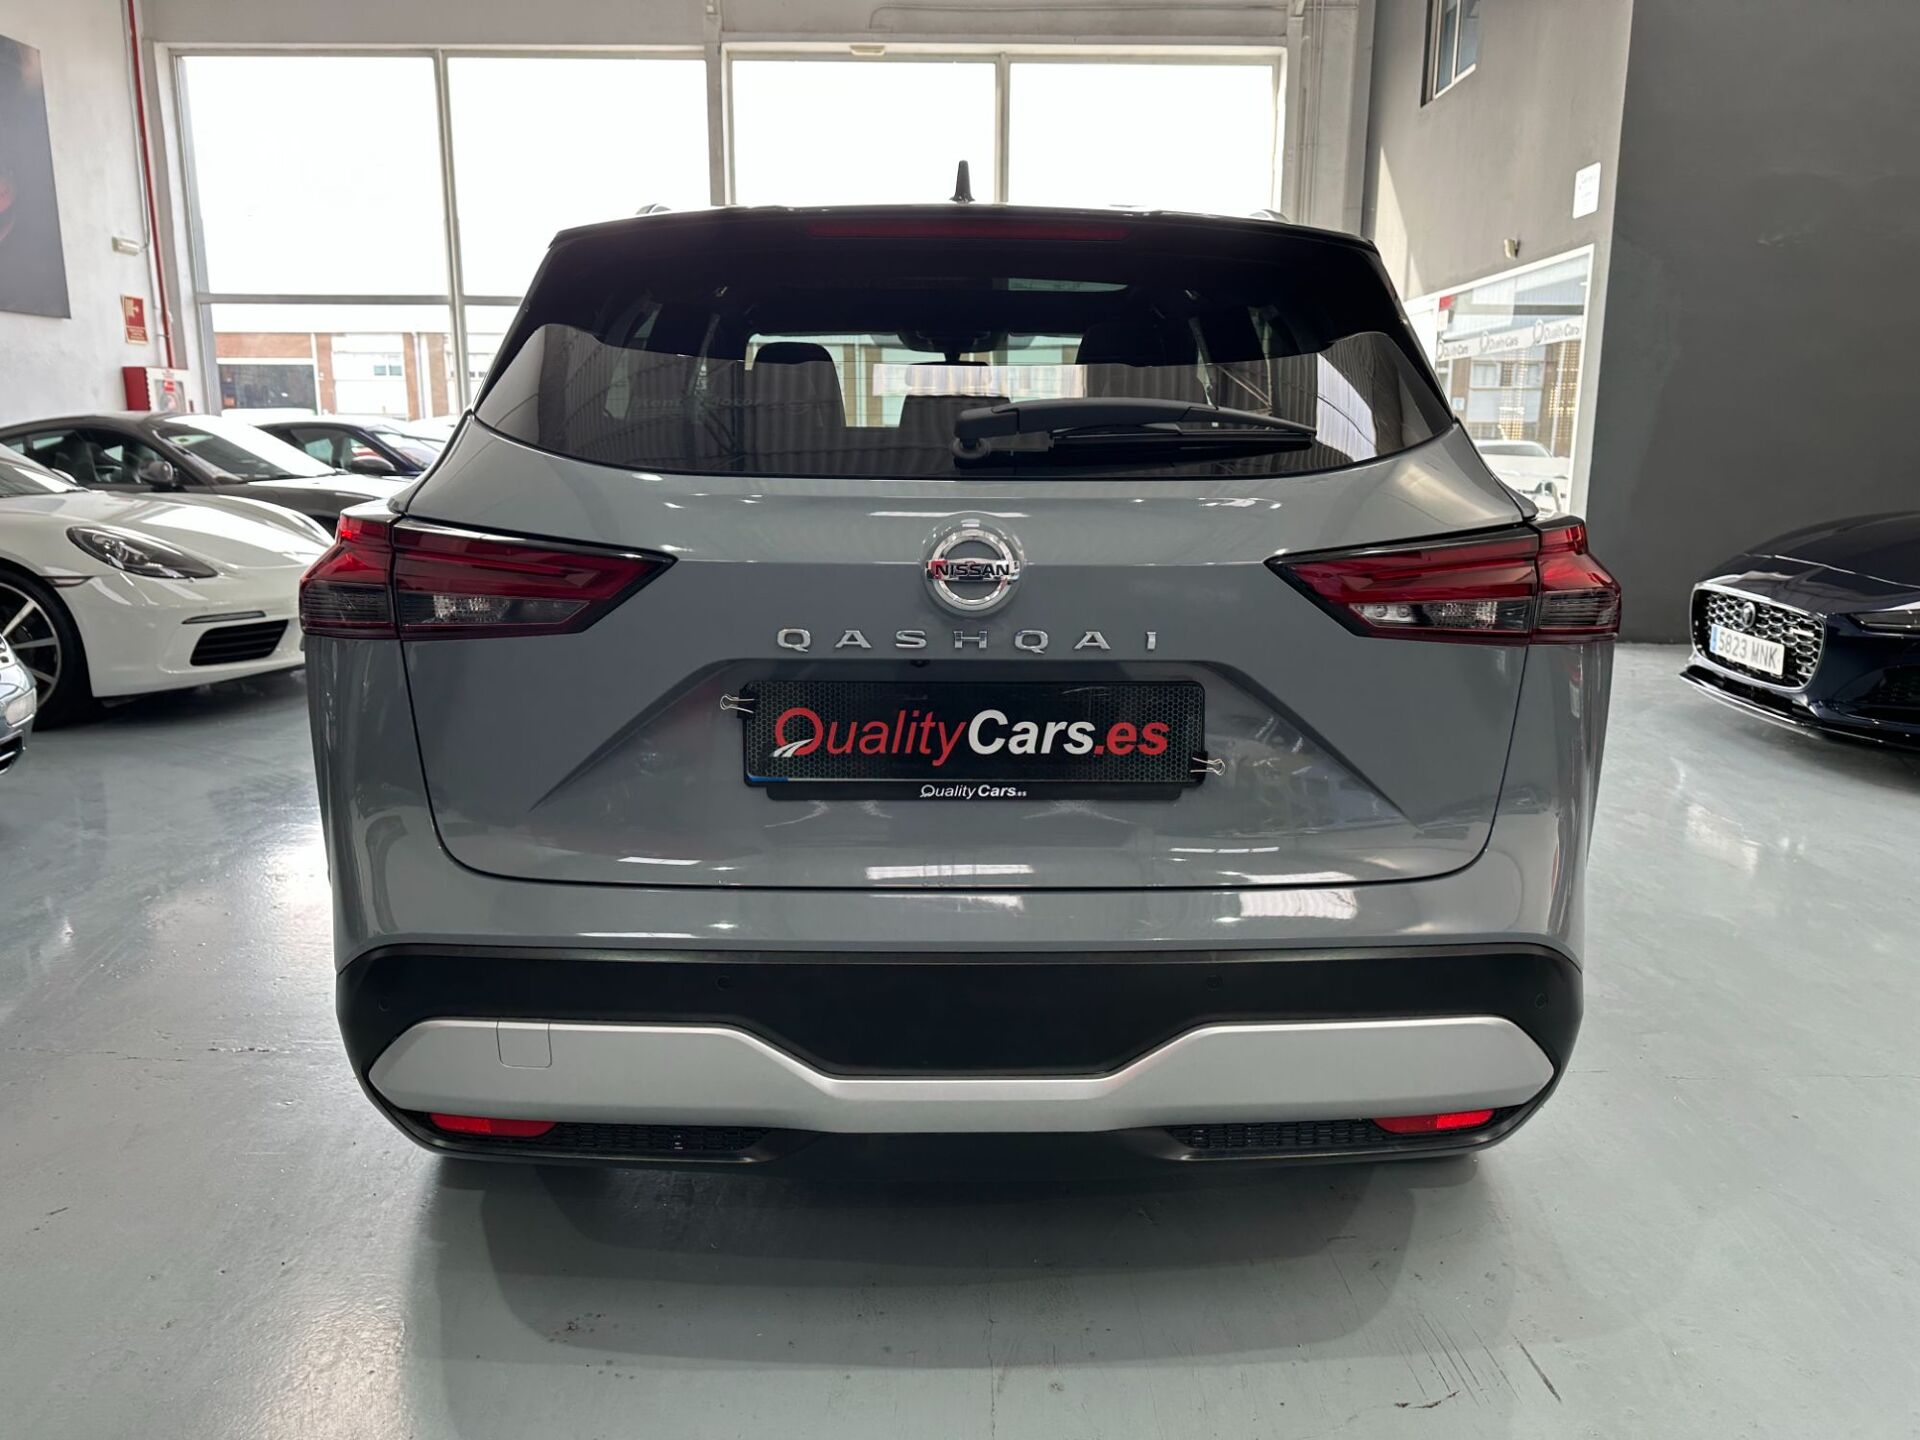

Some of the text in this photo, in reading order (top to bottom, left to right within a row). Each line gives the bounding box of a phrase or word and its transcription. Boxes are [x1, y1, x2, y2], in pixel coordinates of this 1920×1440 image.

[935, 563, 1010, 577] NISSAN
[776, 628, 1157, 654] QASHQAI
[1718, 631, 1778, 669] 5823 MNK
